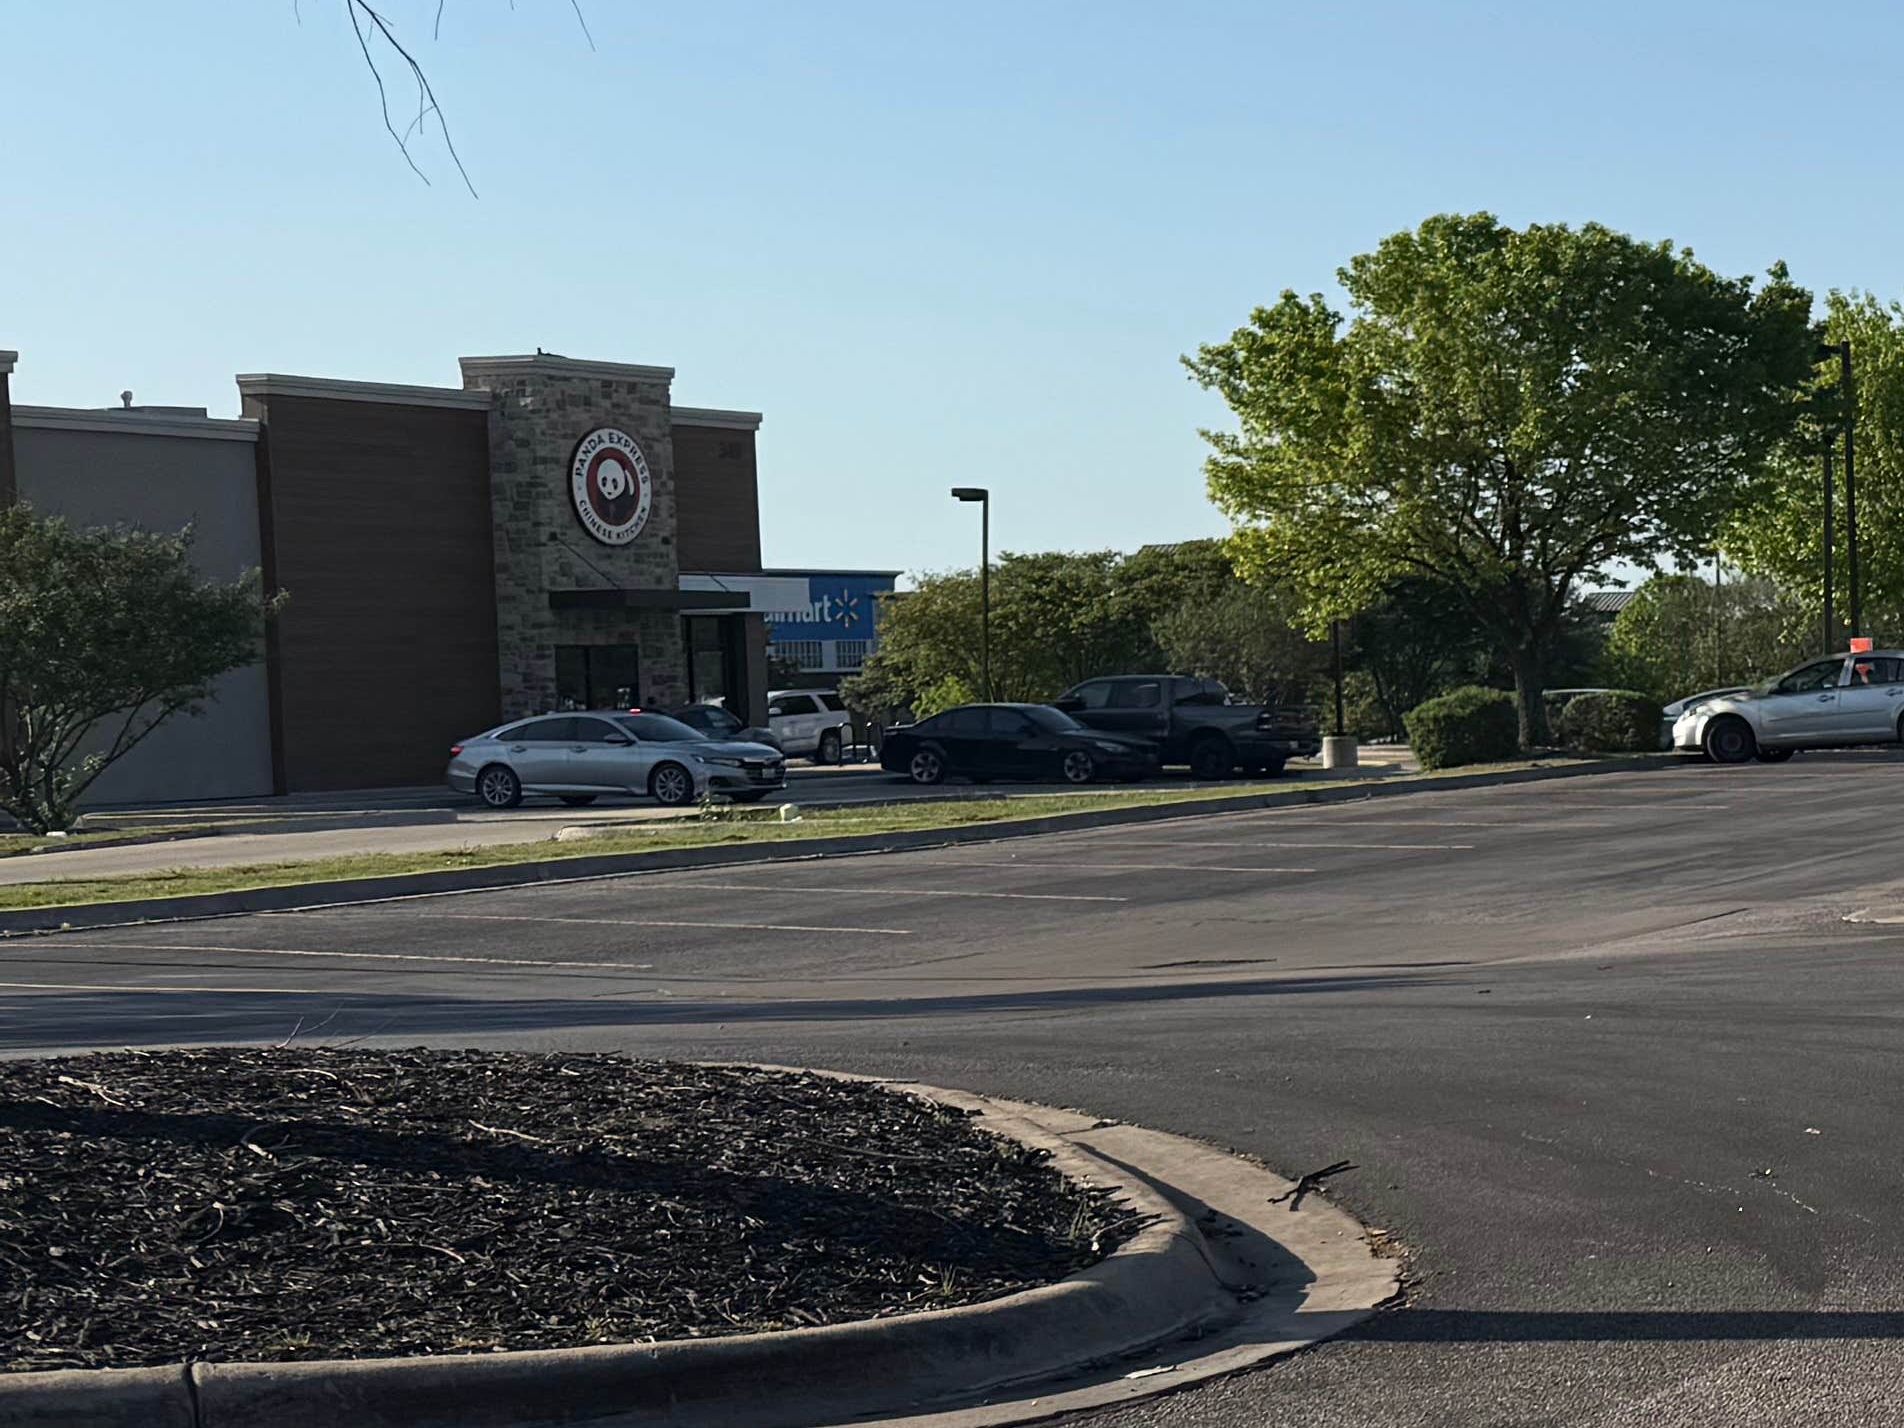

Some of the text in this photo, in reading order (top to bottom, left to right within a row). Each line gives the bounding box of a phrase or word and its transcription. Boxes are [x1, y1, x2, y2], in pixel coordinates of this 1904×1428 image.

[575, 432, 649, 485] PANDA EXPRESS
[579, 499, 613, 539] CHINESE
[763, 594, 833, 623] amart
